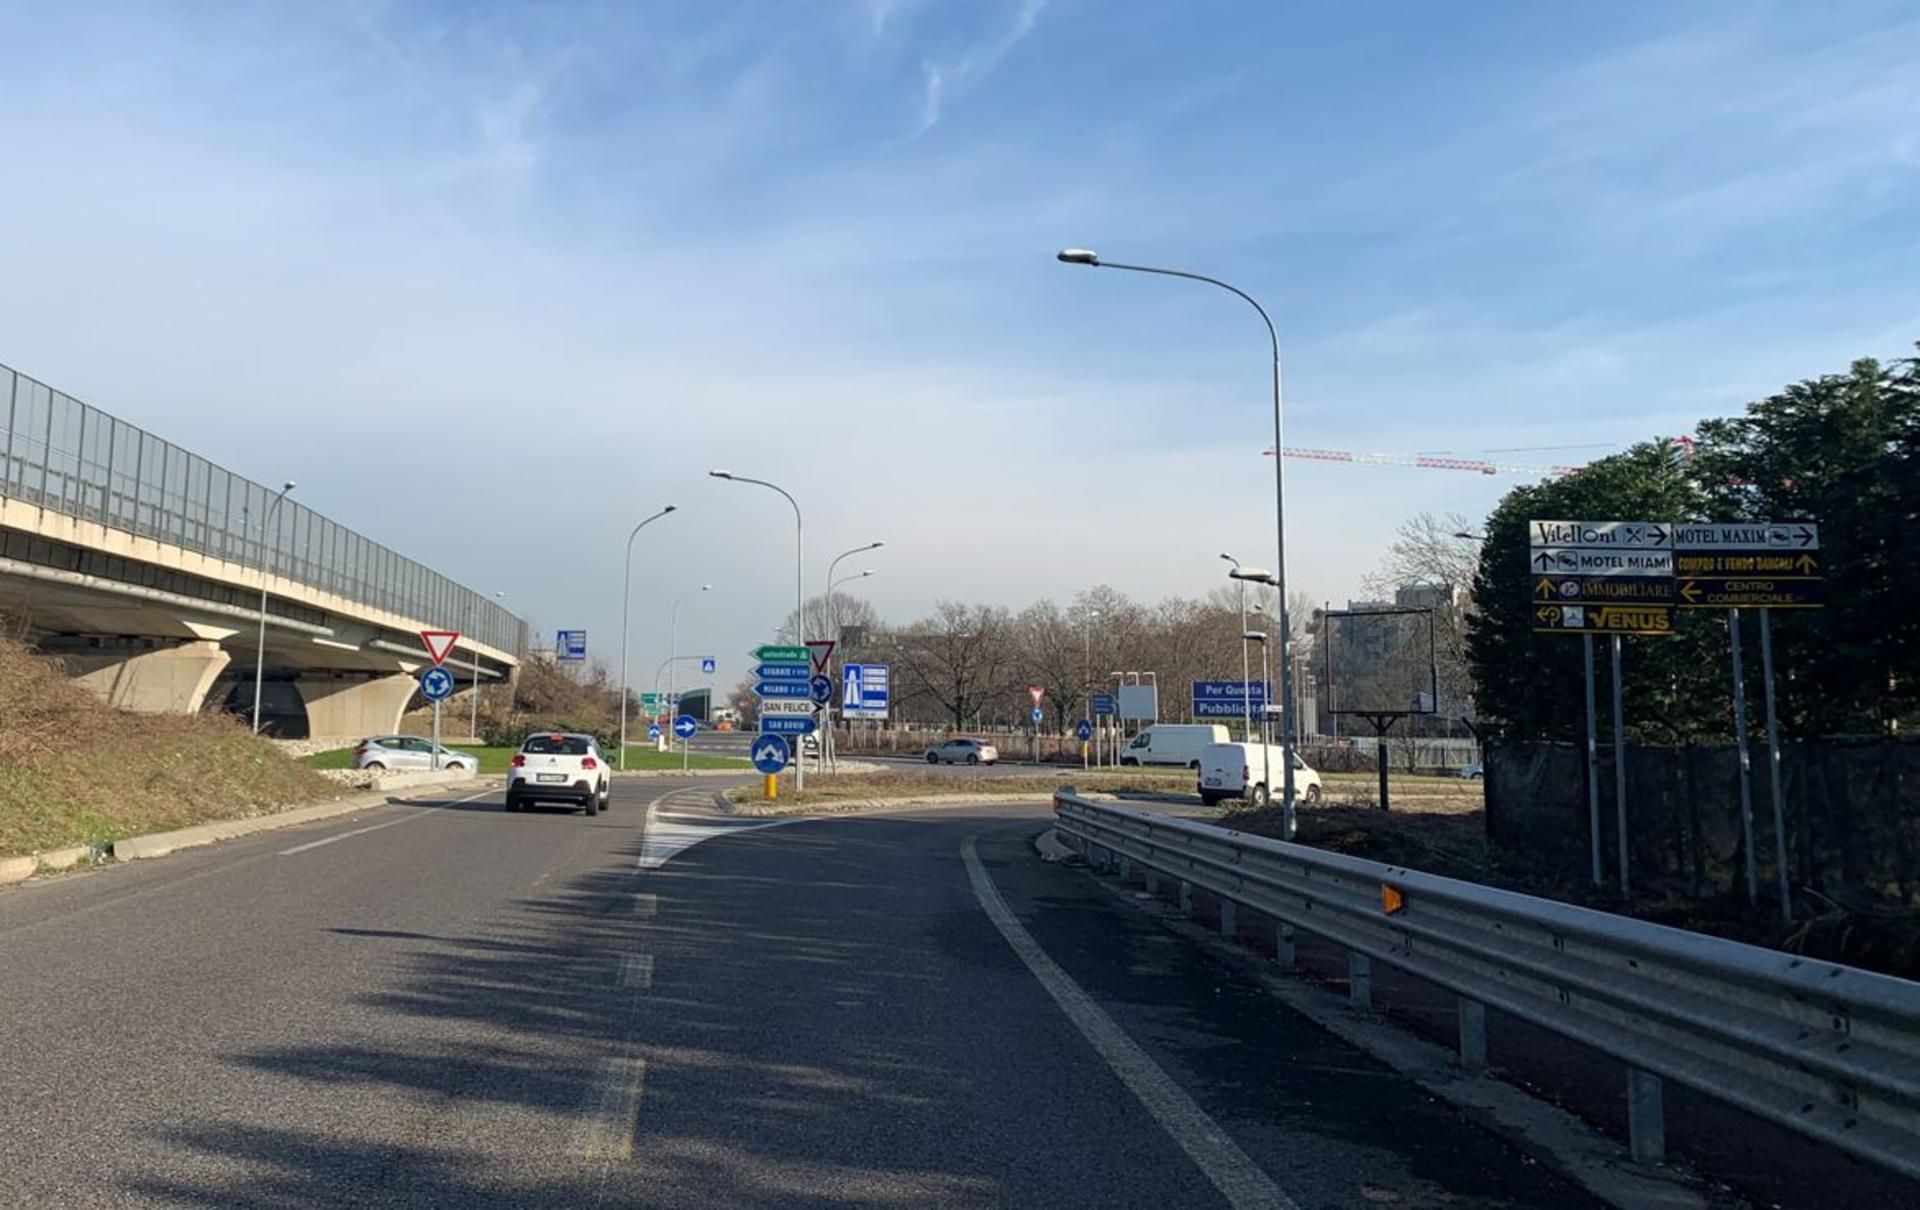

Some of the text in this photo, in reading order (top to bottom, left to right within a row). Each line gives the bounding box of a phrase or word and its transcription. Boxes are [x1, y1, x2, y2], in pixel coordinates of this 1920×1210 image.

[1675, 529, 1767, 544] MOTEL MAXIM
[1581, 556, 1671, 568] MOTEL MIAMI
[1582, 583, 1673, 597] IMMOBILIARE
[1725, 581, 1774, 591] CENTRO
[1707, 593, 1794, 603] COMMERCIALE
[1588, 607, 1670, 629] VENUS
[1206, 685, 1222, 695] Per
[763, 703, 811, 712] SAN FELICE
[1199, 703, 1265, 714] Pubblict
